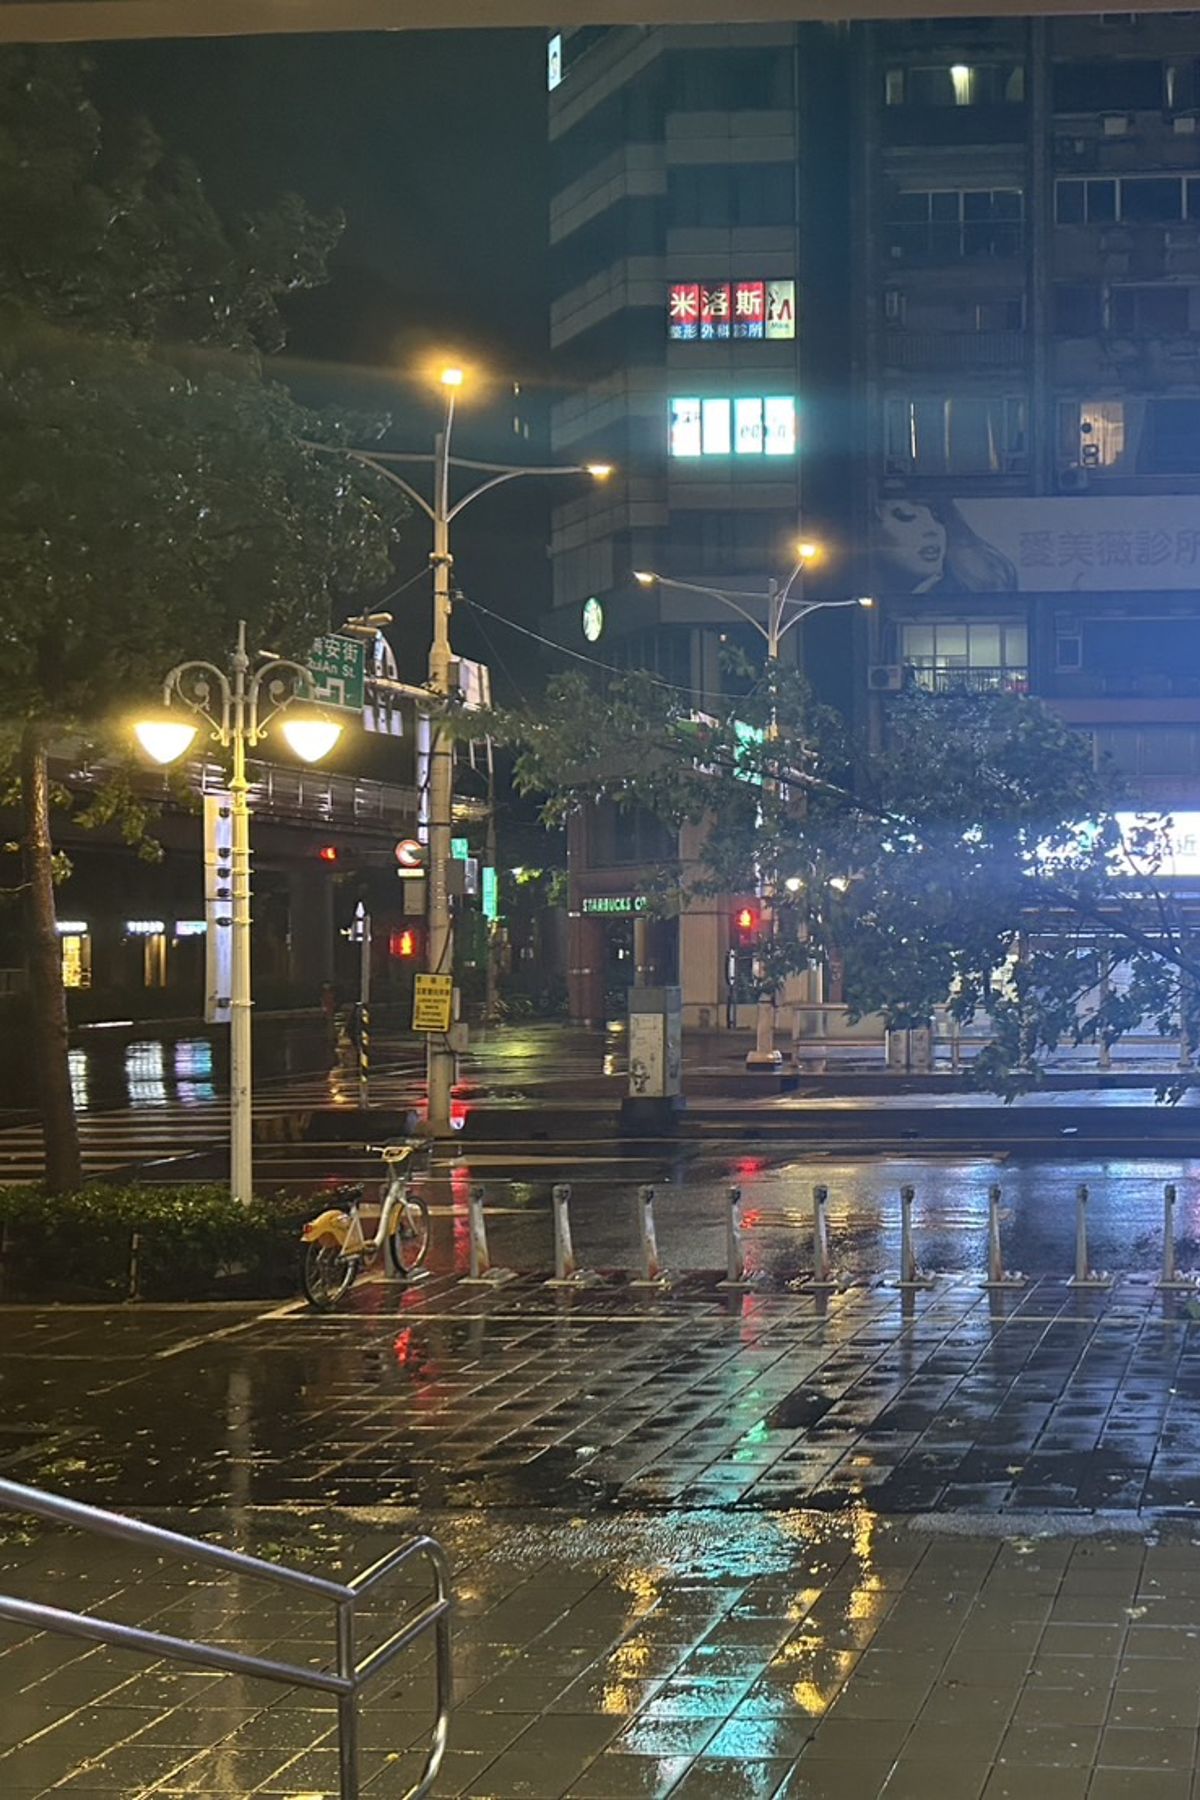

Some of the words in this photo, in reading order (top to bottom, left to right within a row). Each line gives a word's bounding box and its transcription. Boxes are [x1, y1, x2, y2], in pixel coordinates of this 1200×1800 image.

[669, 289, 763, 318] 米洛斯
[670, 323, 763, 339] 整形外科診所
[583, 897, 631, 912] STARBUCKS
